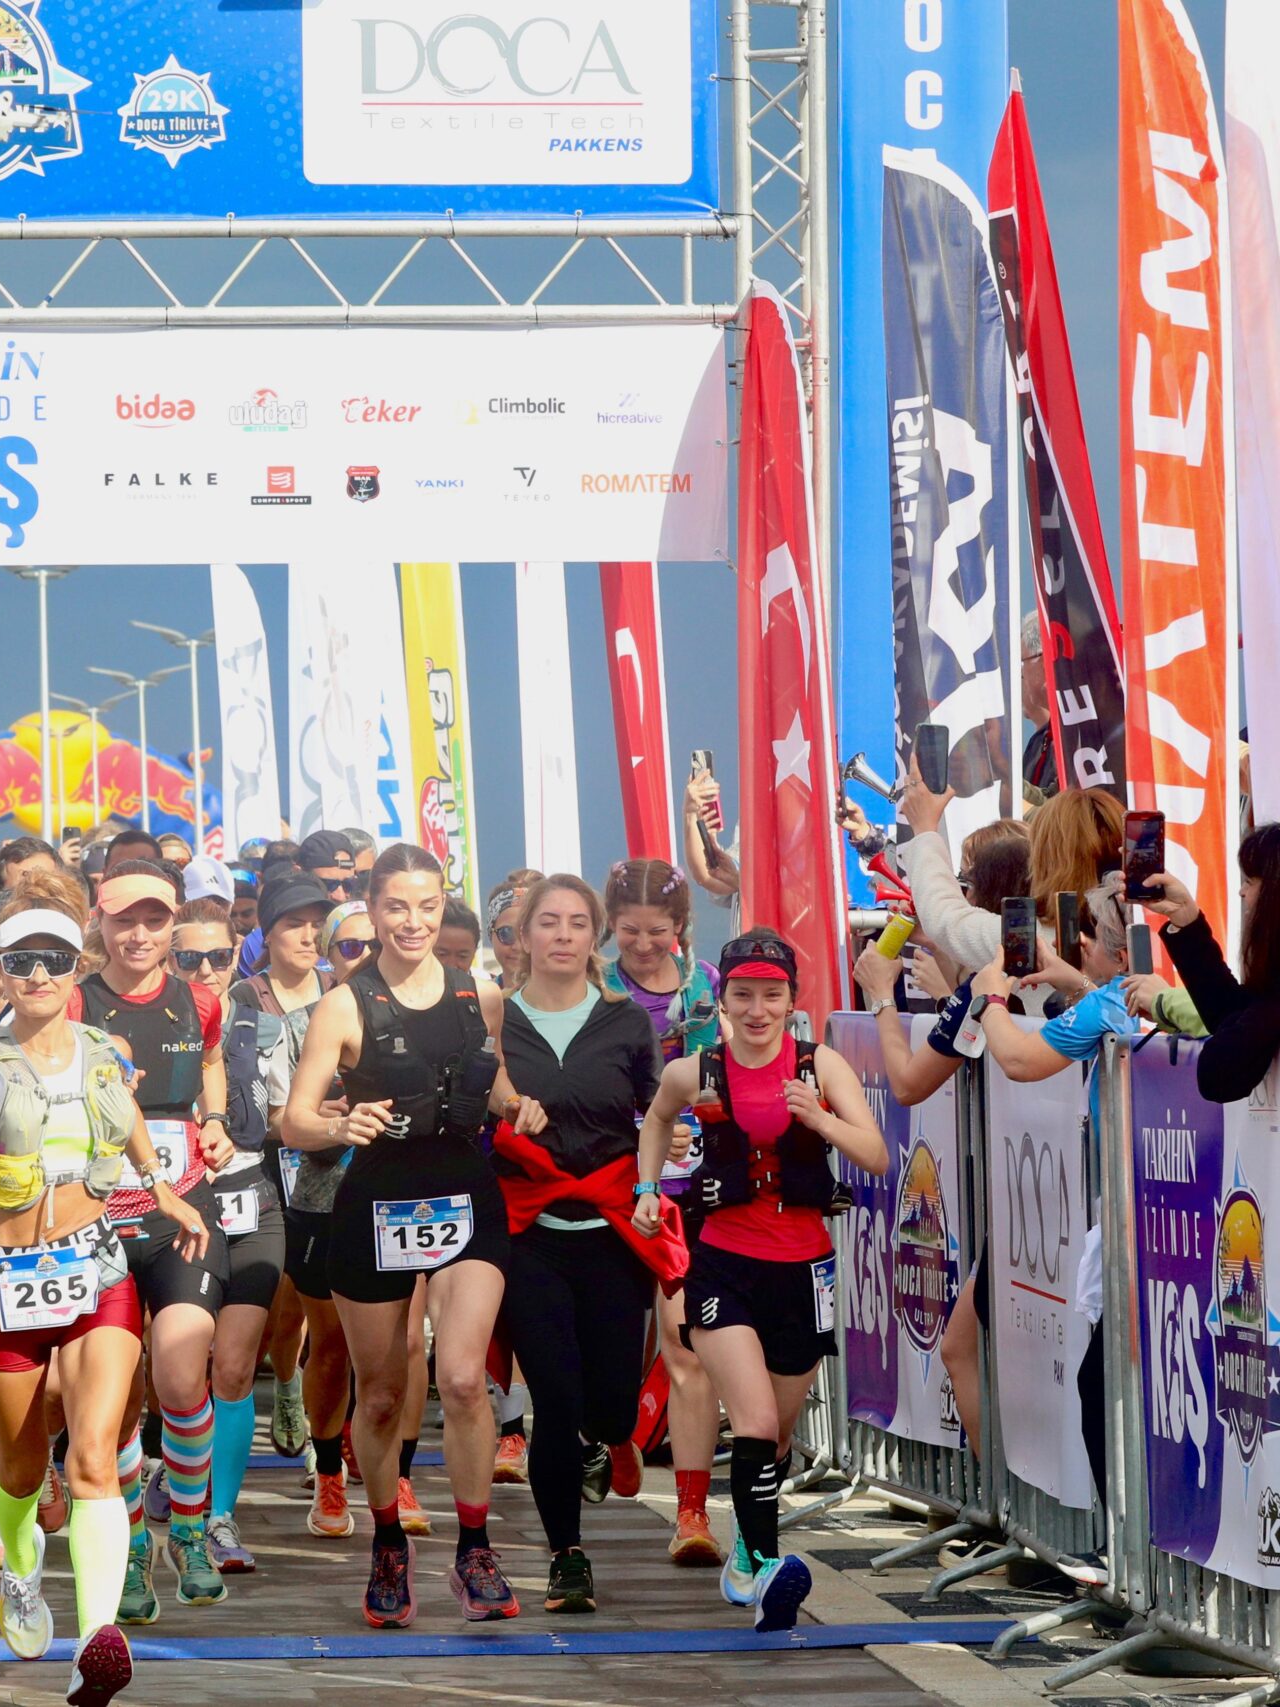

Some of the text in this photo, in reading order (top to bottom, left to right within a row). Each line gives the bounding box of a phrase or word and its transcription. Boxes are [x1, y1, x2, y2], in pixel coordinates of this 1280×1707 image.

[351, 13, 643, 98] DOCA
[147, 89, 200, 112] 29K
[136, 116, 210, 132] DOCA TİRİLYE
[361, 111, 644, 130] Textile Tech
[157, 133, 188, 142] ULTRA
[548, 138, 643, 152] PAKKENS
[115, 393, 195, 421] bidaa
[228, 399, 308, 429] uludağ
[488, 397, 566, 414] Climbolic
[596, 411, 663, 424] hicreative
[103, 472, 218, 487] FALKE
[414, 479, 465, 488] YANKI
[580, 473, 694, 494] ROMATEM
[161, 1041, 203, 1053] naked
[1142, 1108, 1197, 1184] TARİHİN
[1004, 1131, 1070, 1284] DOCA
[391, 1221, 459, 1250] 152
[1143, 1192, 1202, 1260] İZİNDE
[13, 1274, 88, 1310] 265
[841, 1205, 889, 1372] KOŞ
[897, 1262, 921, 1298] DOCA
[914, 1306, 935, 1326] ULTRA
[1009, 1297, 1048, 1348] Textile
[1147, 1278, 1210, 1490] KOŞ
[1224, 1350, 1245, 1393] DOCA
